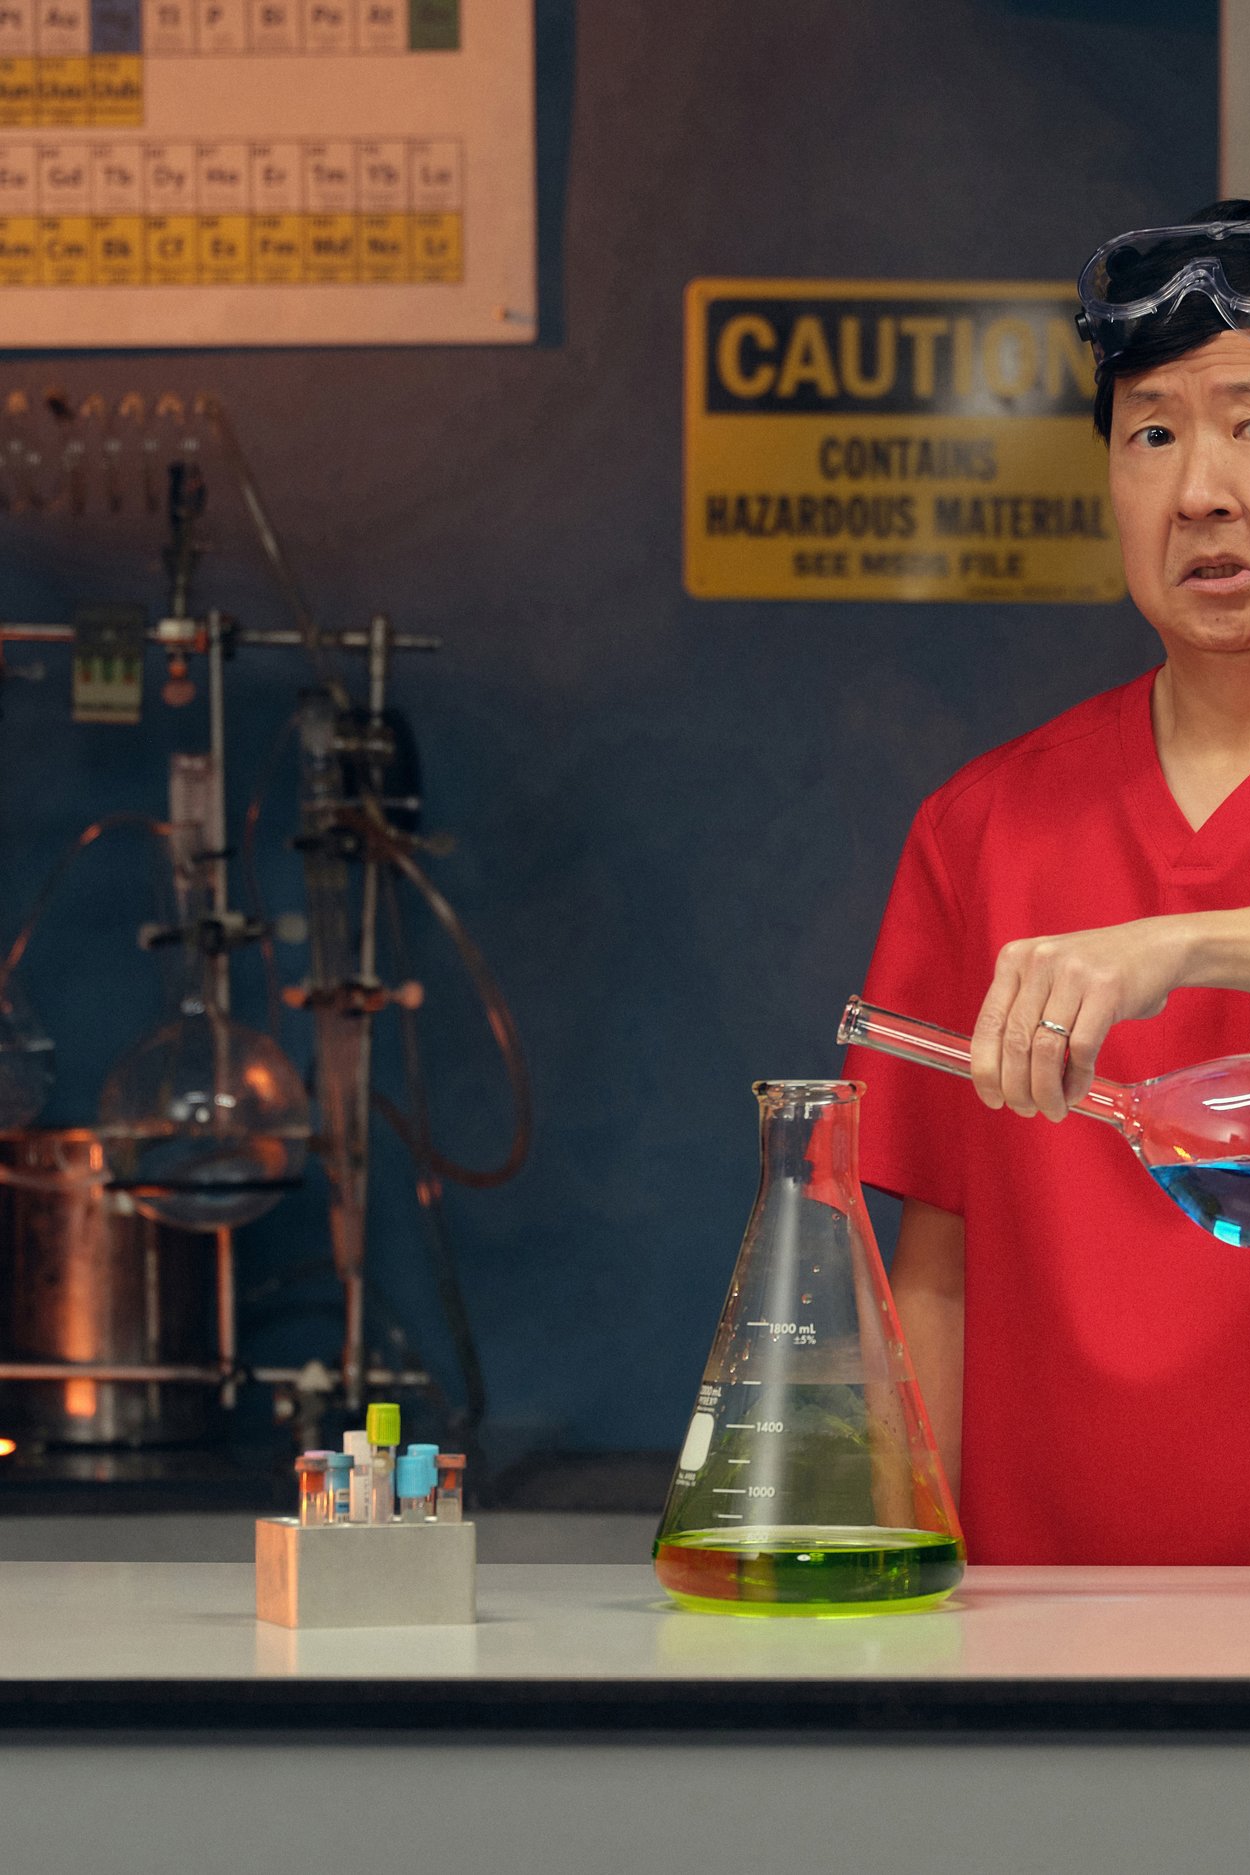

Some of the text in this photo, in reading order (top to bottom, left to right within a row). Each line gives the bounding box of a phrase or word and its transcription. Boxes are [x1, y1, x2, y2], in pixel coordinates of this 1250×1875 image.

[717, 315, 1099, 399] CAUTION
[819, 435, 998, 482] CONTAINS
[705, 493, 1108, 541] HAZARDOUS MATERIAL
[793, 552, 848, 578] SEE
[959, 552, 1026, 578] FILE
[769, 1323, 817, 1334] 1800 mL
[793, 1335, 817, 1345] ±5%
[756, 1422, 784, 1433] 1400
[748, 1487, 776, 1498] 1000
